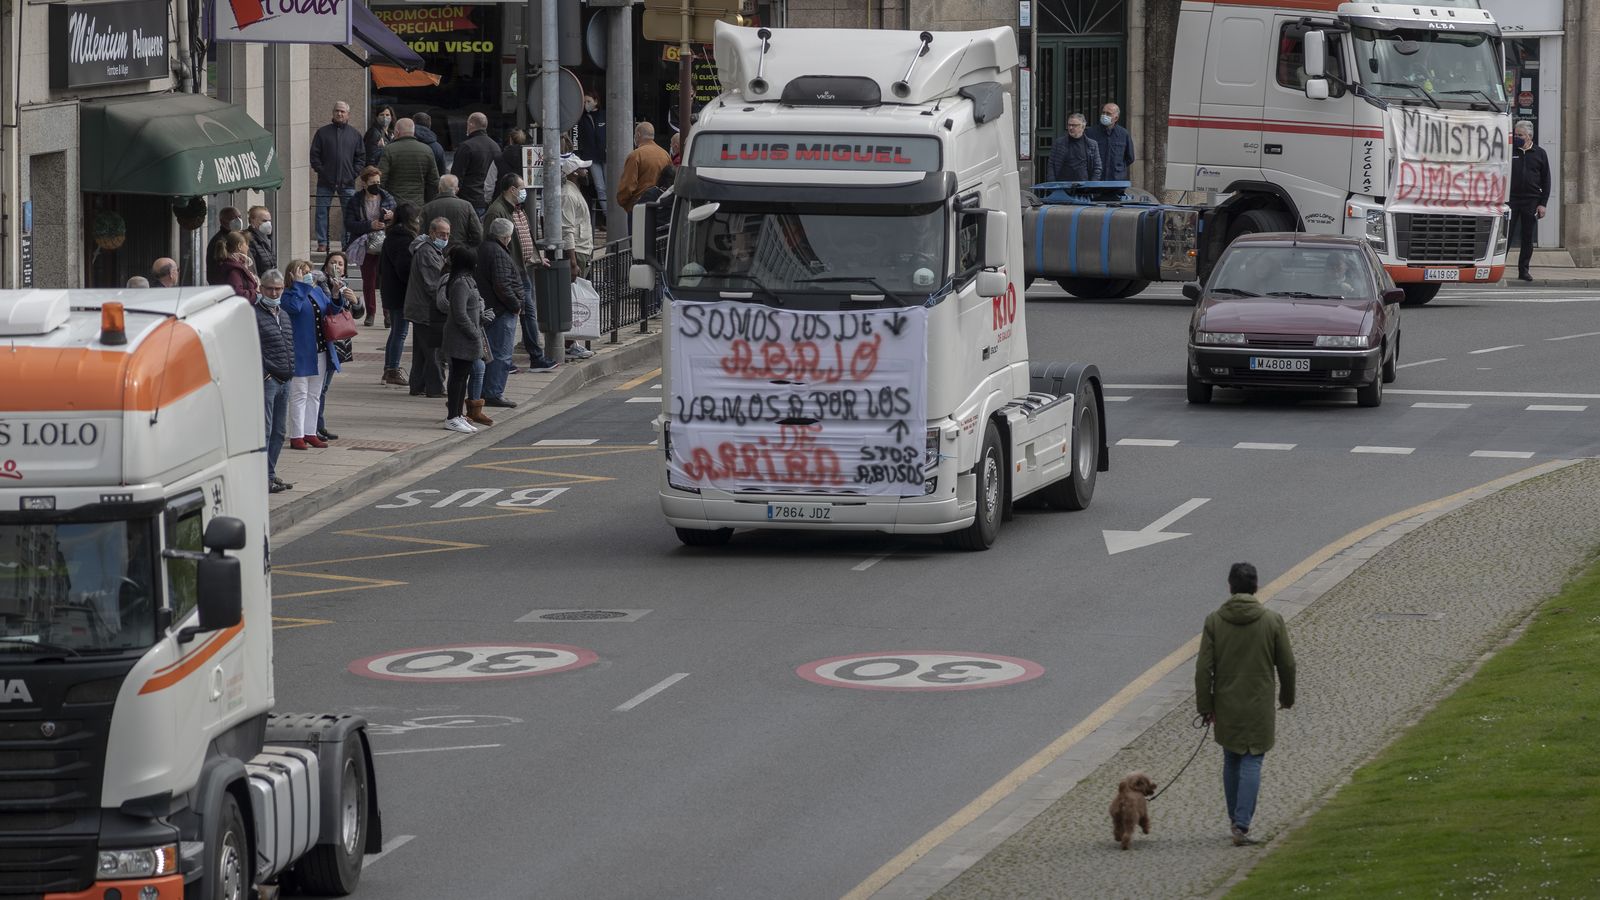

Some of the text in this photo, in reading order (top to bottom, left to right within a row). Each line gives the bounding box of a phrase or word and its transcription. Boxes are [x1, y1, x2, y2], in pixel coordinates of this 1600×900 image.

[375, 5, 464, 21] PROMOCIÓN
[69, 11, 128, 65] Milenium
[1428, 22, 1455, 30] ALBA
[445, 41, 494, 53] VISCO
[1401, 107, 1504, 161] MINISTRA
[720, 143, 912, 165] LUIS MIGUEL
[214, 155, 241, 184] ARCO
[238, 151, 260, 180] IRIS
[1363, 140, 1373, 193] NICOLAS
[1397, 157, 1508, 209] DIMISION
[1477, 268, 1489, 279] SP
[679, 304, 781, 342] SOMOS
[833, 313, 876, 341] DE
[721, 333, 882, 384] ABAJO
[1257, 359, 1309, 370] M 4808 OS
[677, 394, 781, 426] VAMOS
[809, 388, 859, 421] POR
[865, 386, 911, 418] LOS
[22, 422, 98, 446] LOLO
[772, 422, 823, 451] DE
[683, 436, 846, 486] ARRIBA
[859, 446, 918, 464] STOP
[853, 464, 925, 486] ABUSOS
[375, 487, 571, 509] BUS
[775, 506, 831, 520] 7864 JDZ
[386, 650, 559, 674] 30
[834, 657, 1003, 684] 30
